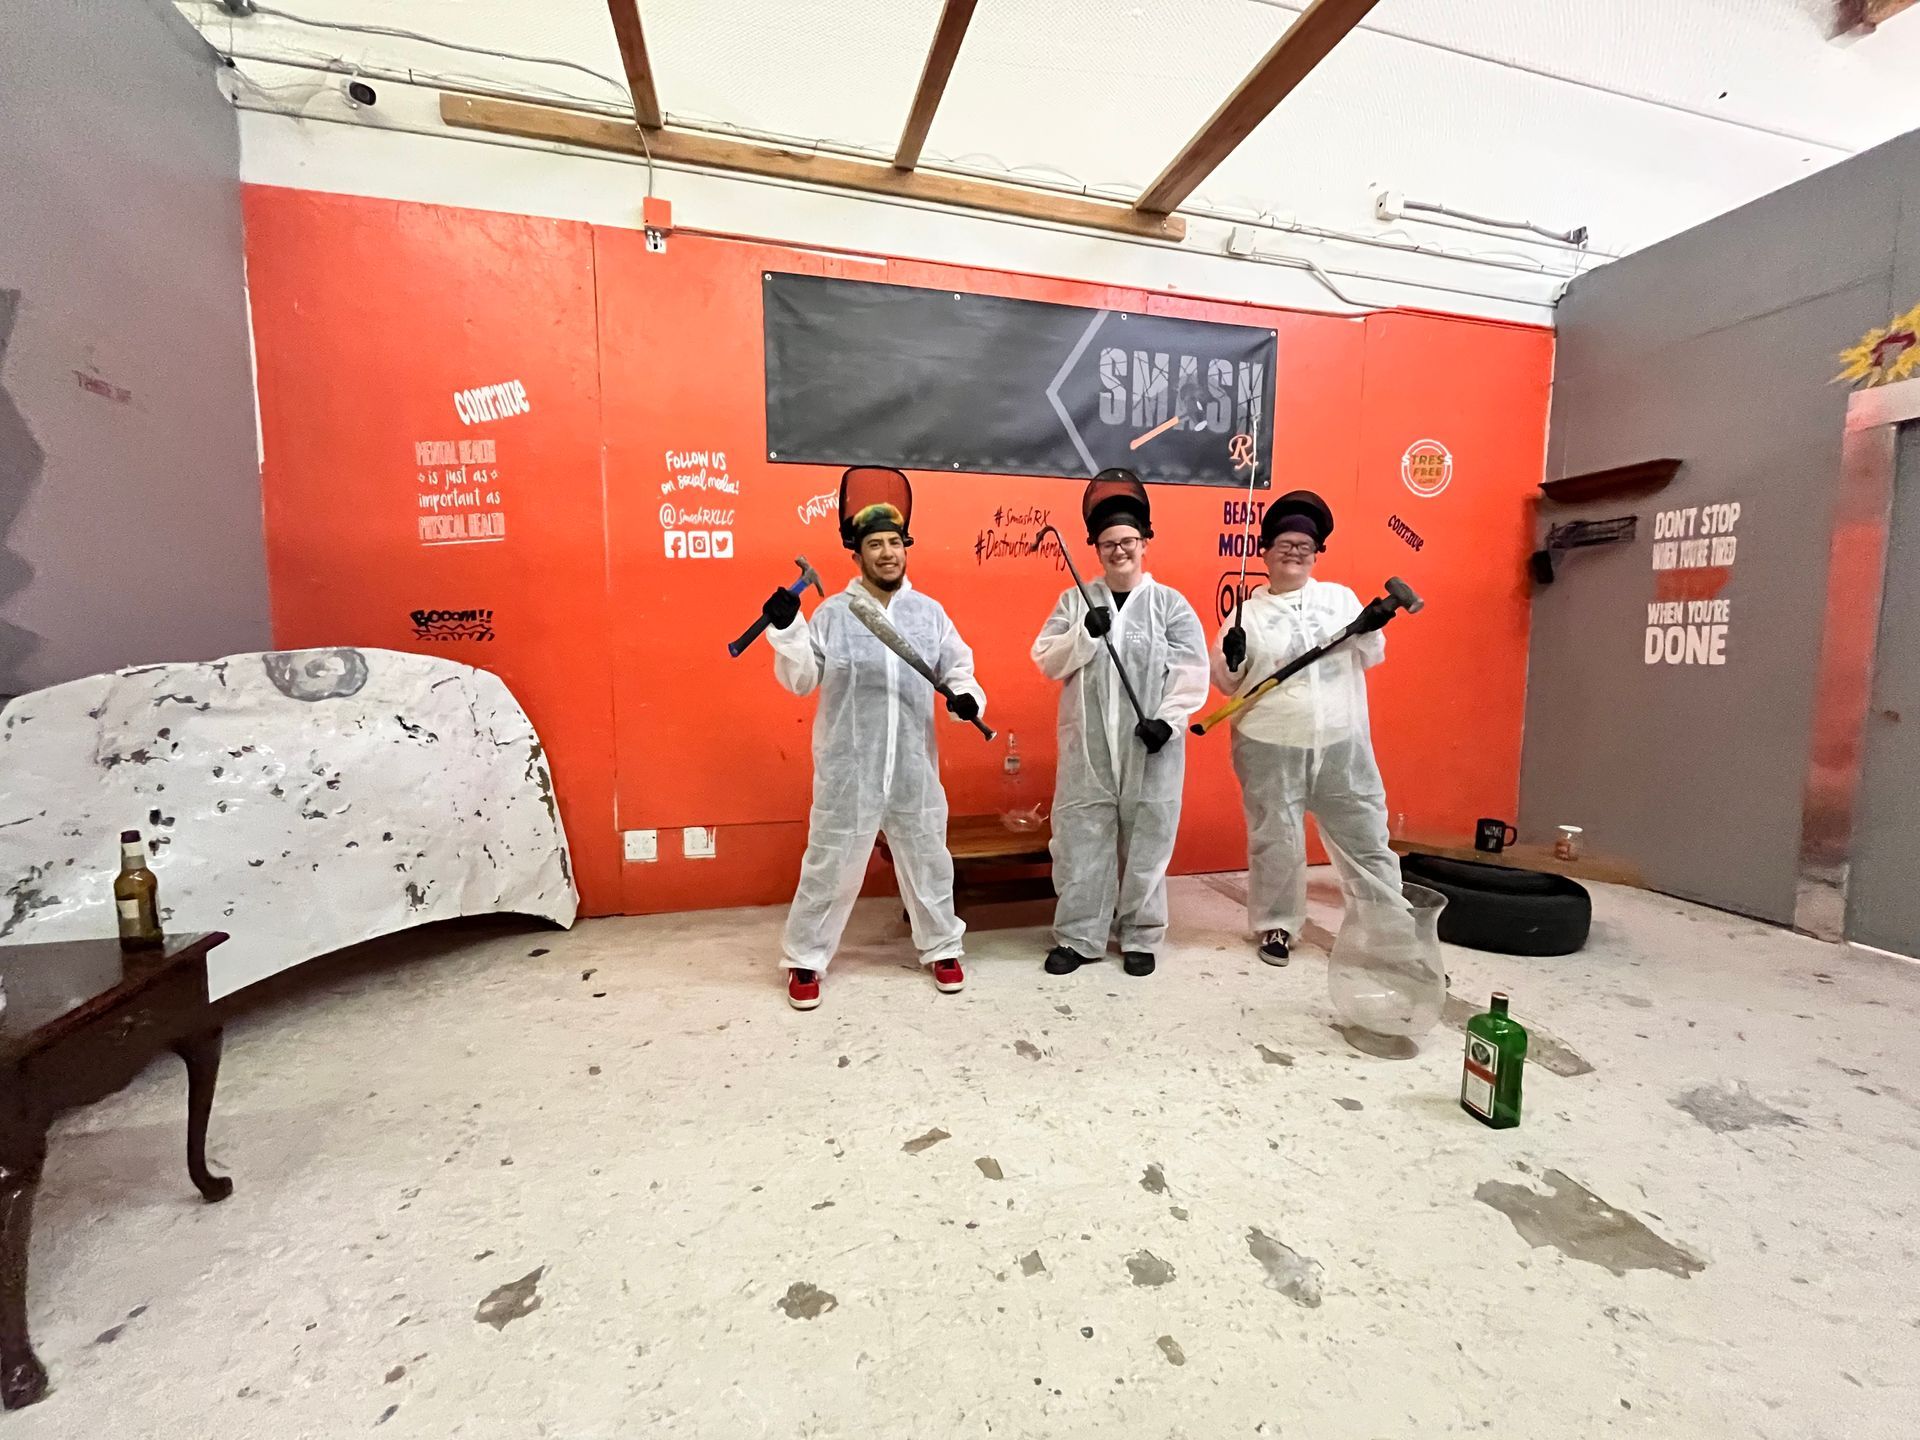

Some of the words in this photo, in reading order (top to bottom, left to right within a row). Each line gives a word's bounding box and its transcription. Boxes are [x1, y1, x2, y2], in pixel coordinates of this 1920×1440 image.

[1099, 347, 1263, 436] SMASH
[428, 471, 438, 485] is
[445, 464, 467, 491] just
[473, 469, 488, 483] as
[661, 480, 676, 495] on
[677, 468, 707, 491] social
[418, 487, 480, 513] important
[486, 491, 501, 505] as
[1223, 501, 1265, 525] BEAST
[1700, 502, 1741, 535] STOP
[1647, 601, 1684, 625] WHEN
[1644, 624, 1729, 665] DONE
